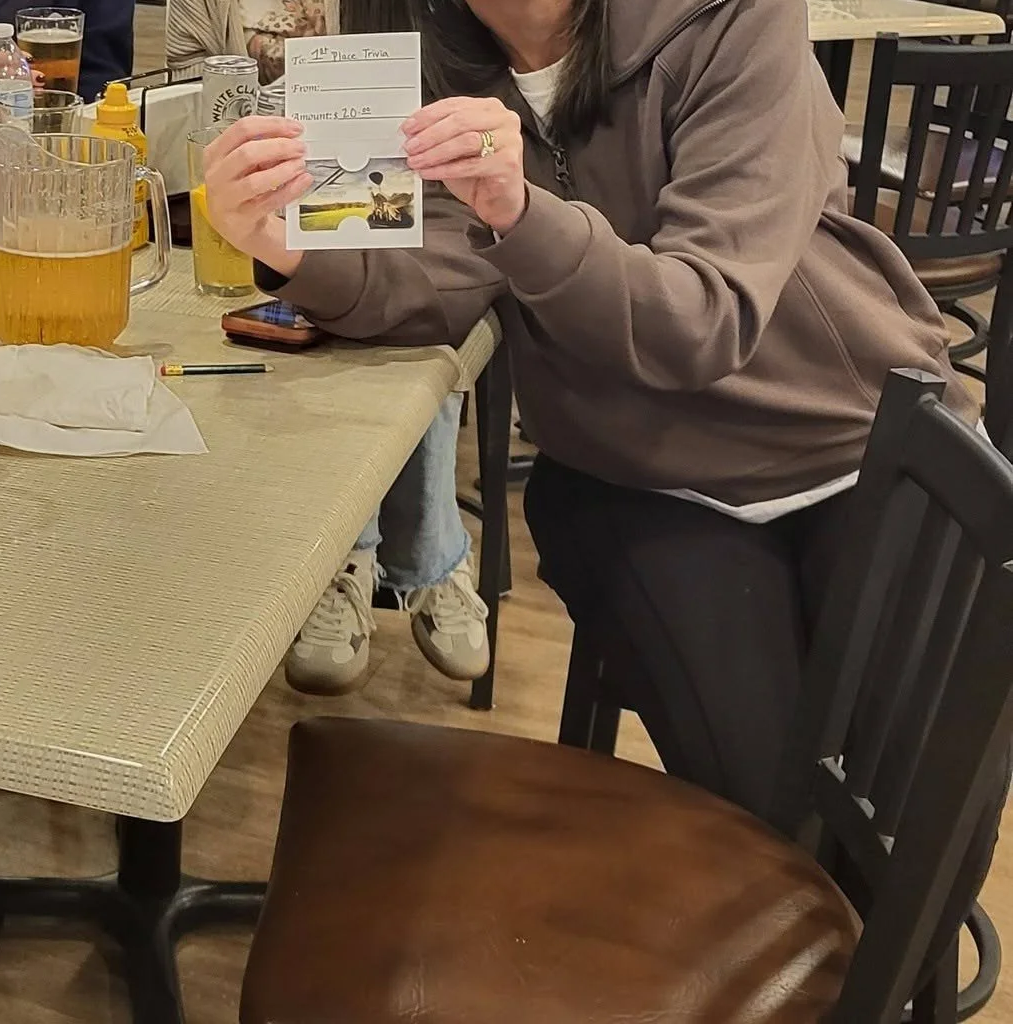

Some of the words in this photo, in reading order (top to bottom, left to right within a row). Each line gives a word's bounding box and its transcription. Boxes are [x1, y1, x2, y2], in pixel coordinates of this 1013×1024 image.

[291, 55, 306, 65] To:
[331, 51, 356, 62] Place
[362, 48, 389, 58] Trivia
[291, 84, 320, 93] From:
[212, 89, 235, 123] WHITE
[236, 85, 257, 98] CLA
